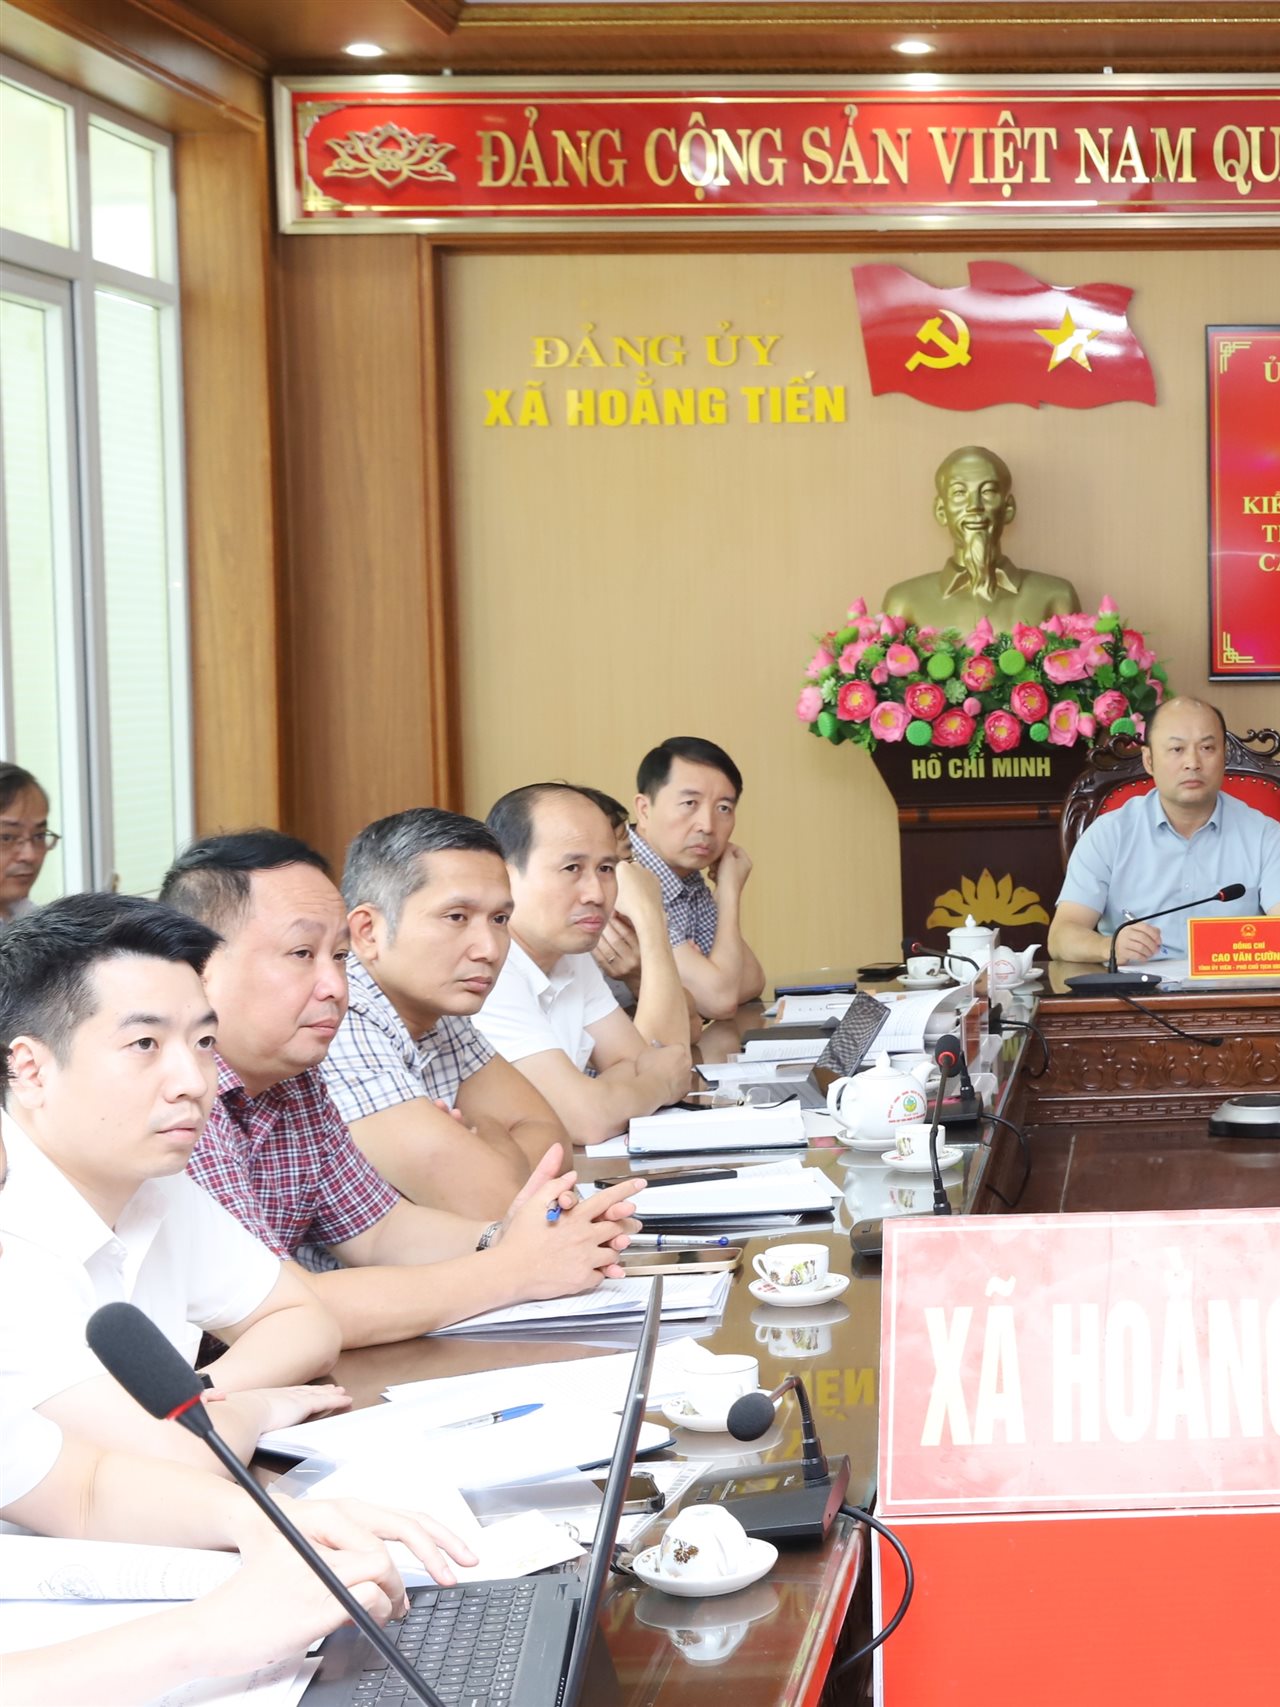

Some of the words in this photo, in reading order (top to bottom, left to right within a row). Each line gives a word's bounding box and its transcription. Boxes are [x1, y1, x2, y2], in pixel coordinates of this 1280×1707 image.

[477, 106, 627, 187] ĐẢNG
[644, 111, 787, 200] CỘNG
[802, 103, 909, 186] SẢN
[928, 110, 1057, 198] VIỆT
[1074, 126, 1197, 184] NAM
[531, 321, 688, 369] ĐẢNG
[704, 321, 782, 367] ỦY
[484, 381, 548, 427] XÃ
[566, 371, 728, 427] HOẰNG
[741, 371, 847, 424] TIẾN
[911, 752, 943, 780] HỒ
[948, 753, 986, 779] CHÍ
[991, 756, 1051, 778] MINH
[1211, 953, 1231, 962] CAO
[1233, 951, 1252, 962] VĂN
[920, 1276, 1025, 1447] XÃ
